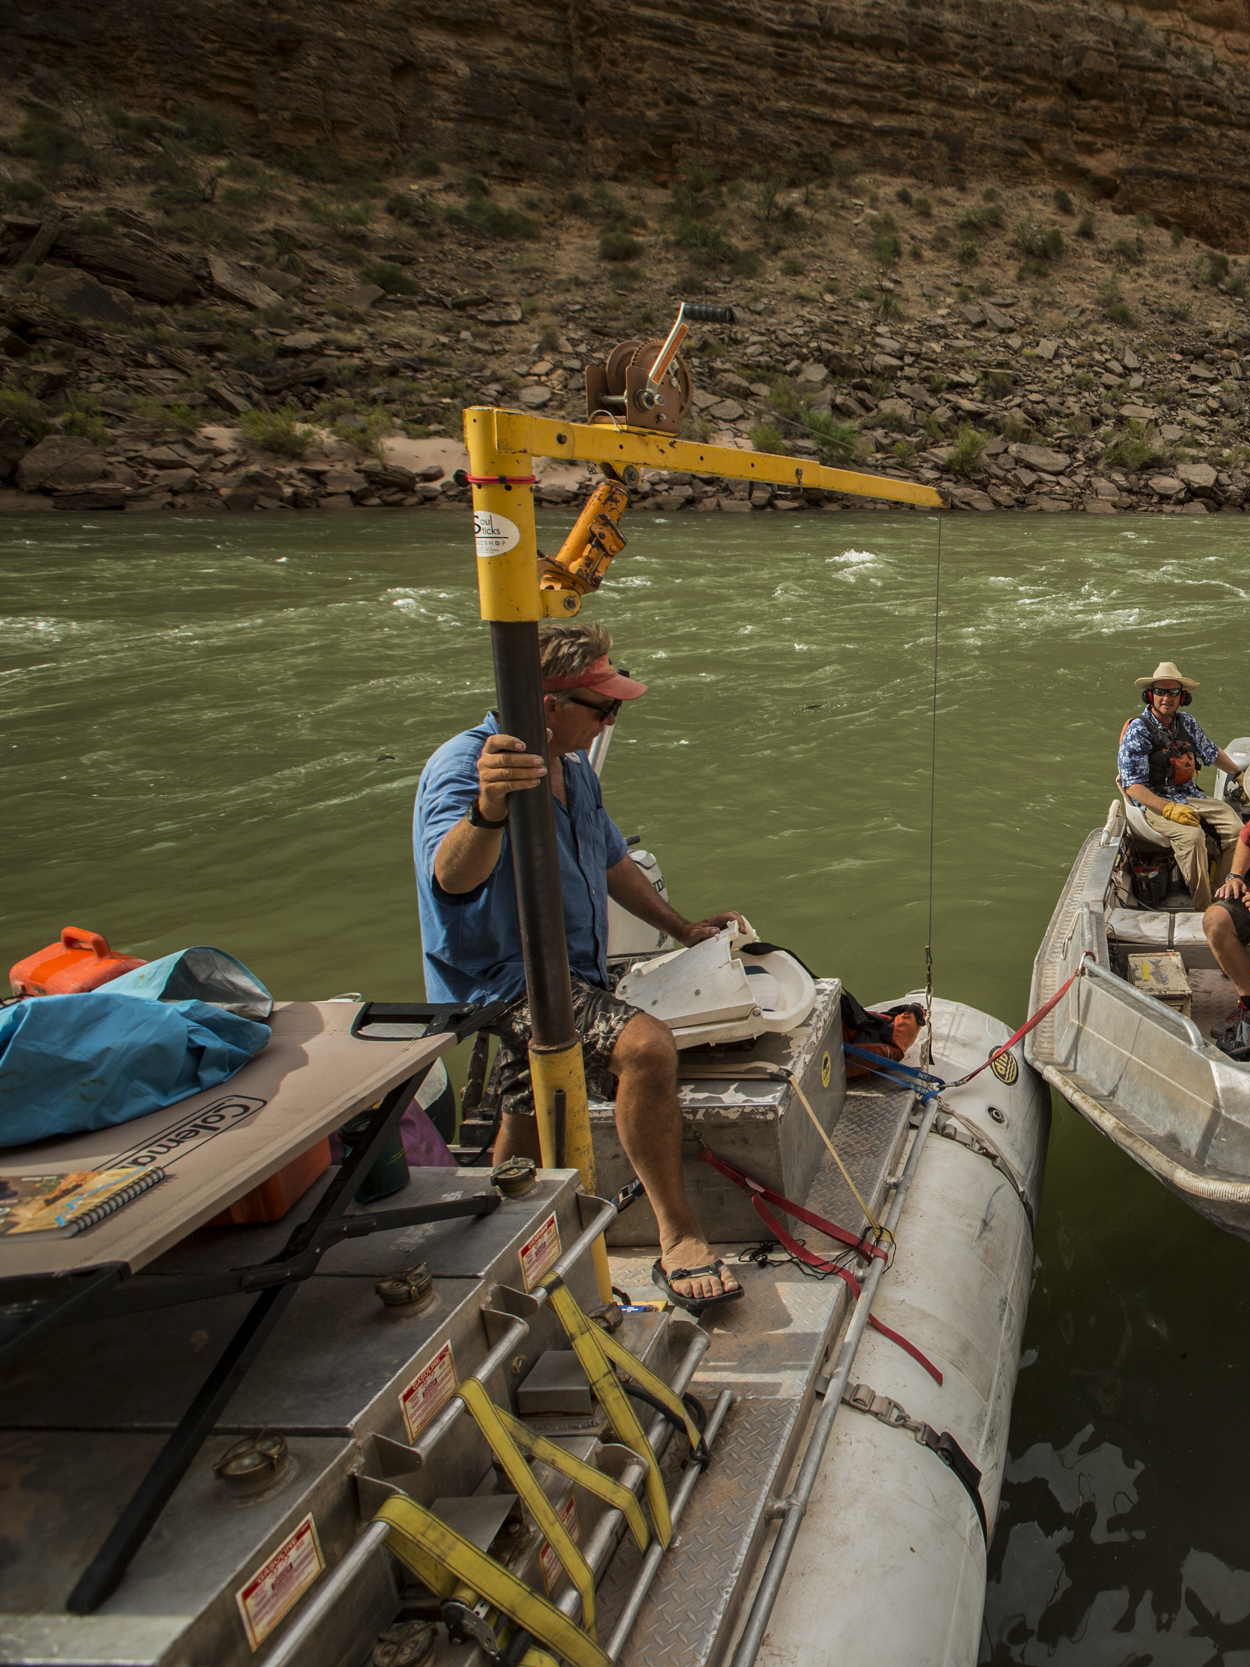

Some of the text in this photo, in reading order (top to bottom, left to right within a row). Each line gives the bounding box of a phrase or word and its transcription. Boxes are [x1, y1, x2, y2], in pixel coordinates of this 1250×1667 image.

[117, 1103, 251, 1169] Colema
[412, 1358, 440, 1391] GASOLINE
[257, 1538, 298, 1584] GASOLINE
